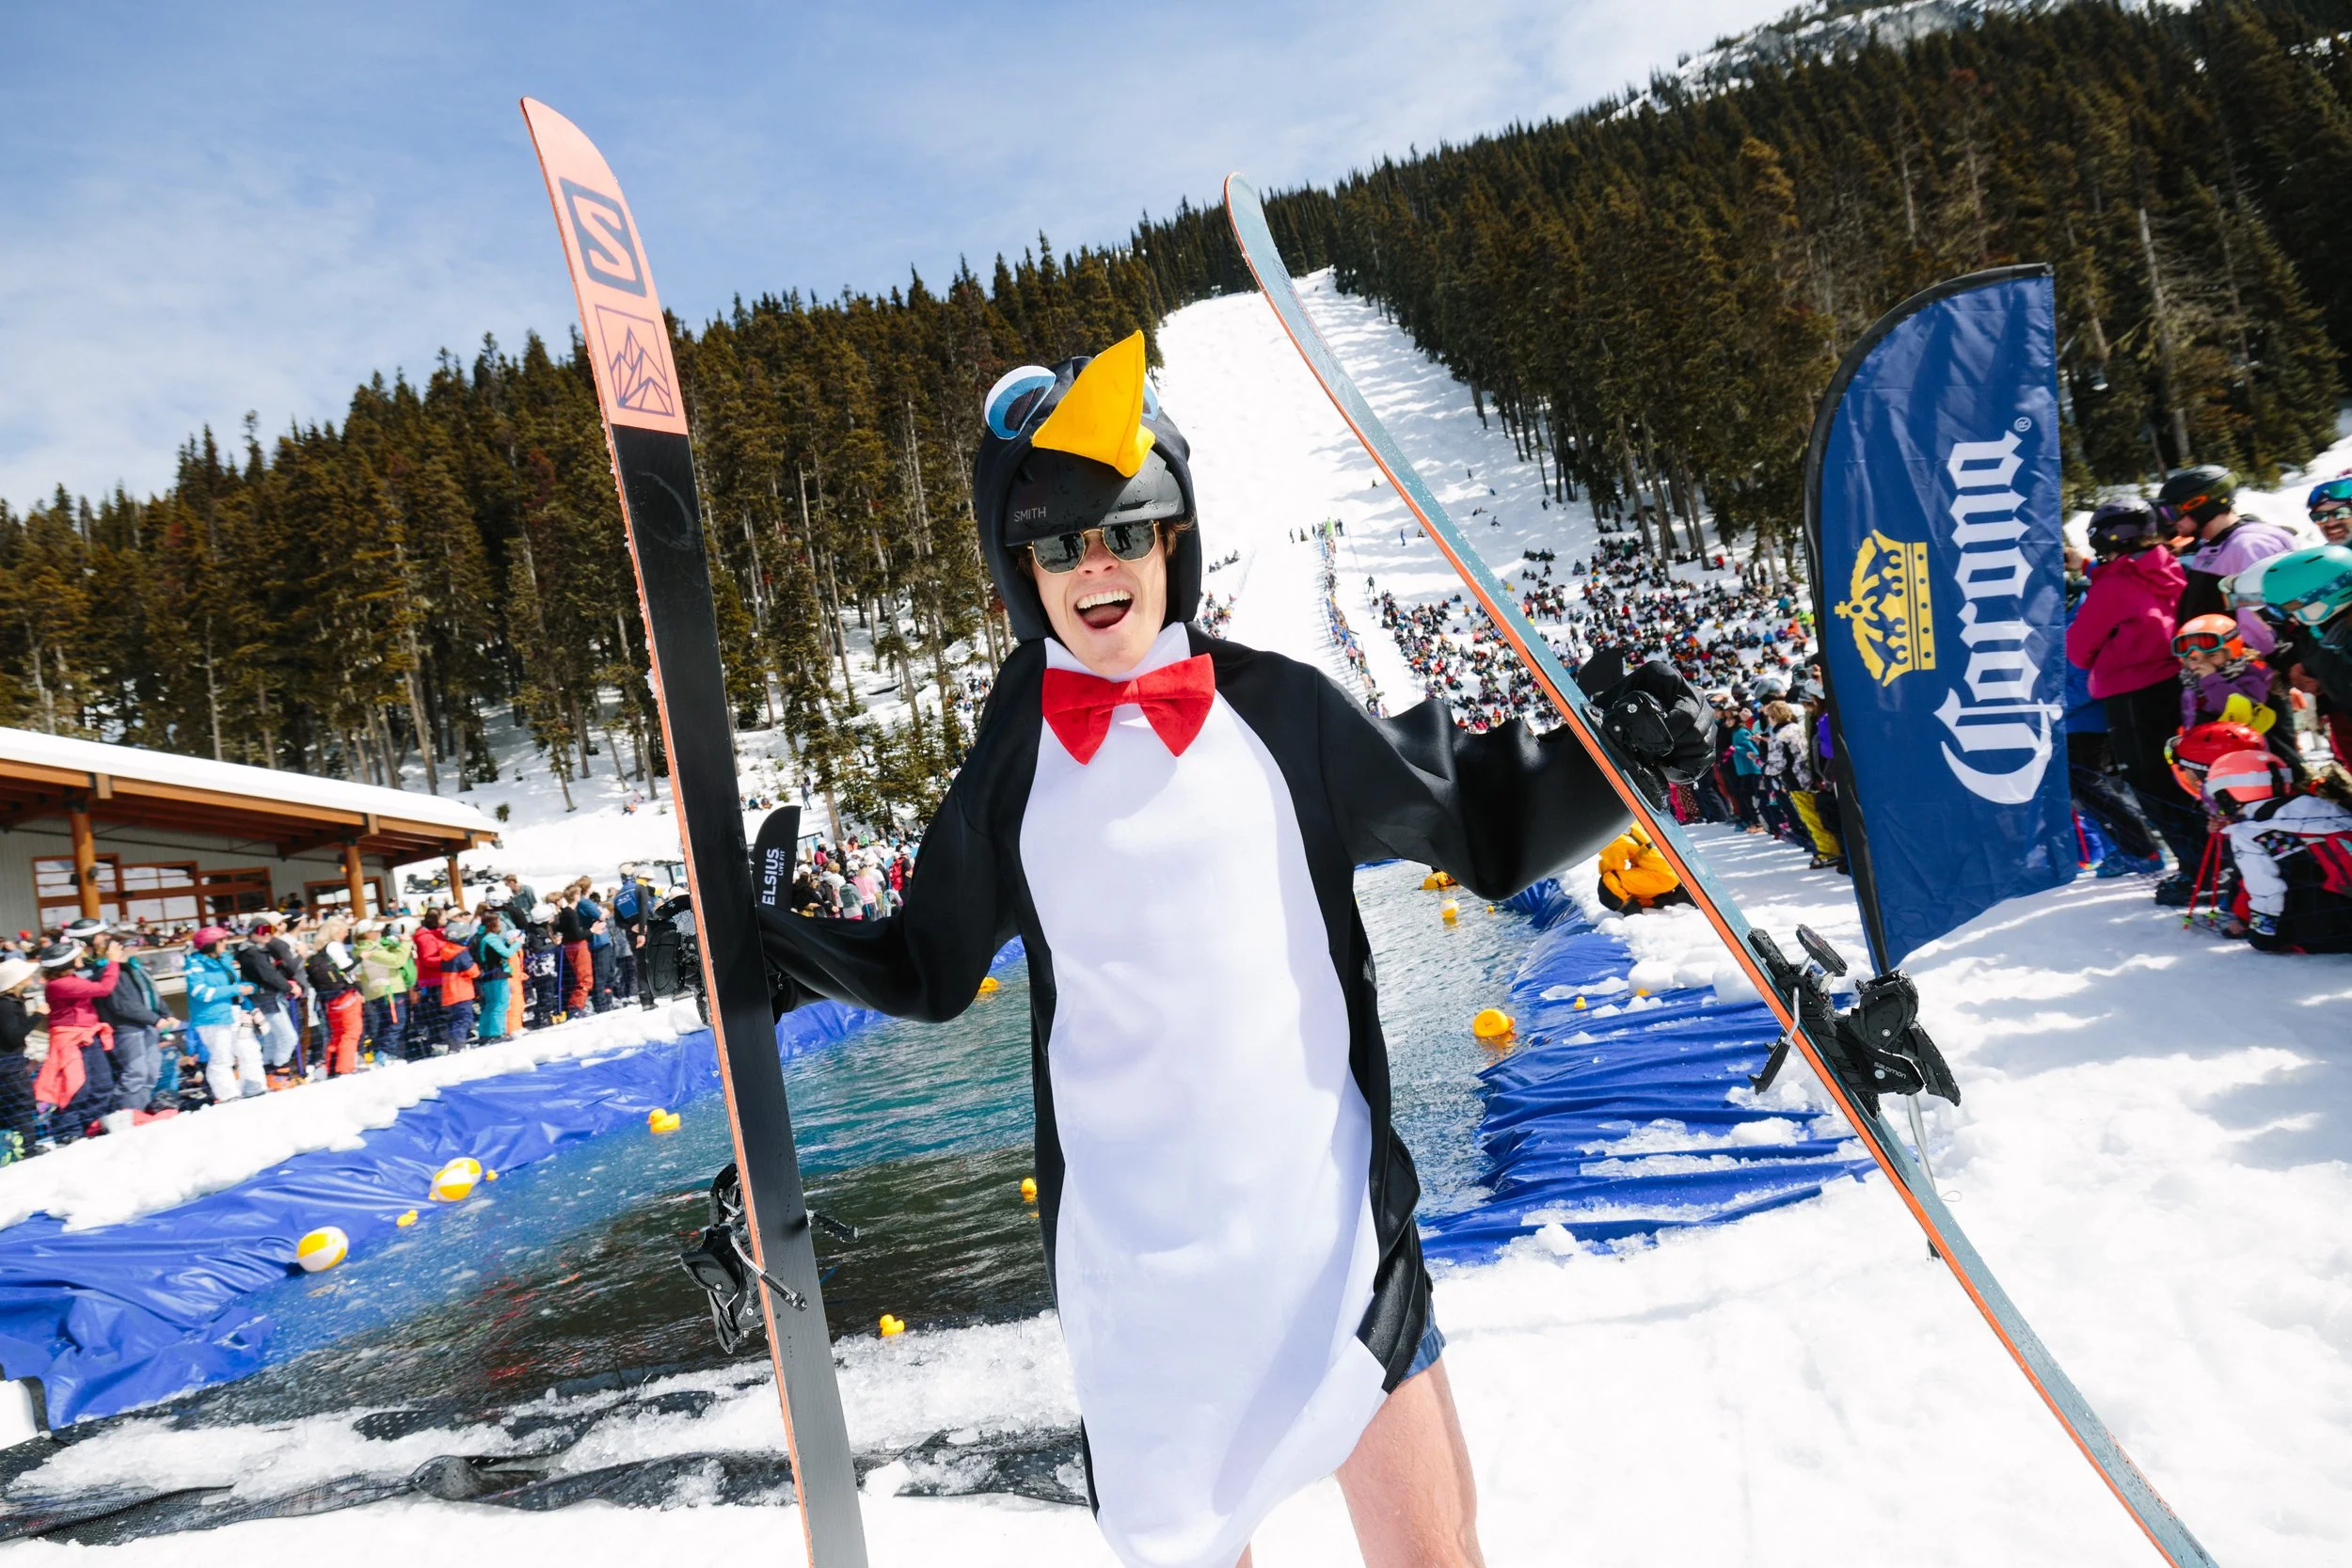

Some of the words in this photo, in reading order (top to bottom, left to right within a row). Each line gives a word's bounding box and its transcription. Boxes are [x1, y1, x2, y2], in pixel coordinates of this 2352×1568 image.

[571, 195, 638, 282] S
[1014, 506, 1046, 522] SMITH
[762, 848, 779, 906] ELSIUS
